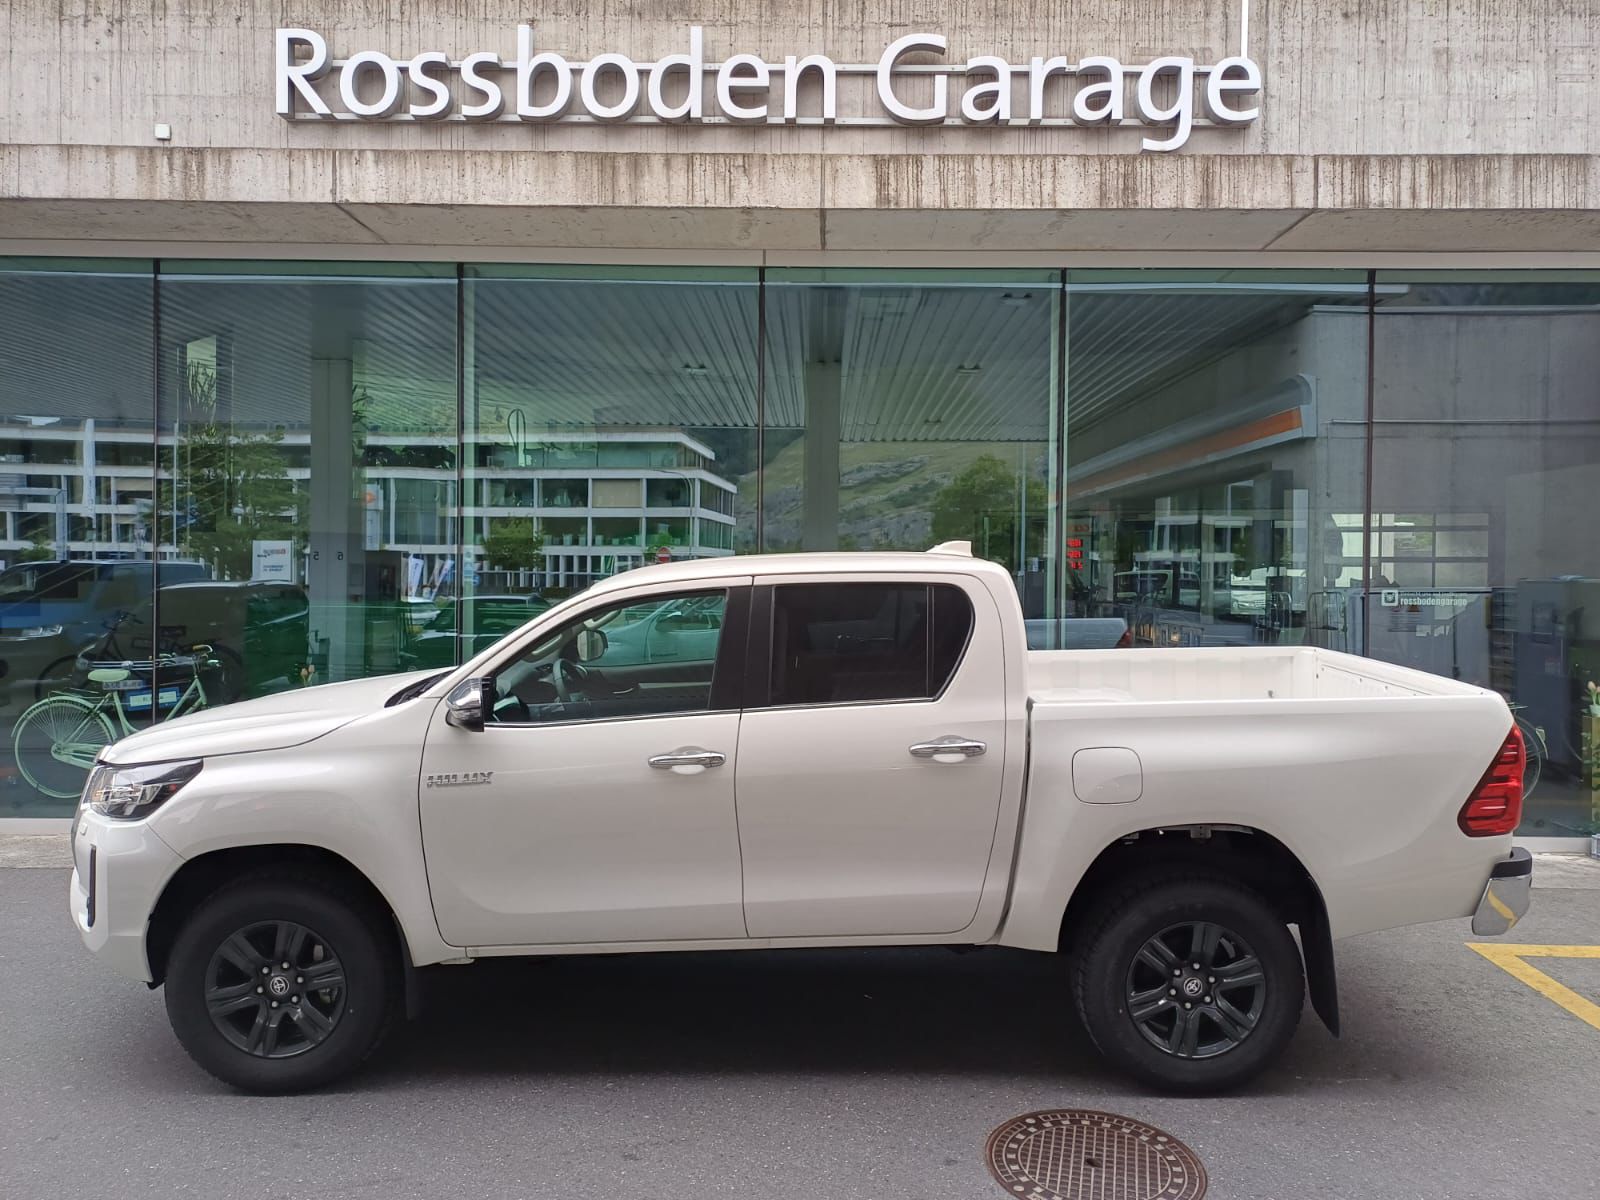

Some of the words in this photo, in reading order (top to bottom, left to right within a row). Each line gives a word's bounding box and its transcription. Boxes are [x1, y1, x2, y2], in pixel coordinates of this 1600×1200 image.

[275, 24, 837, 123] Rossboden
[876, 33, 1262, 153] Garage
[1400, 597, 1468, 607] rossbodengarage
[426, 771, 494, 788] HILUX
